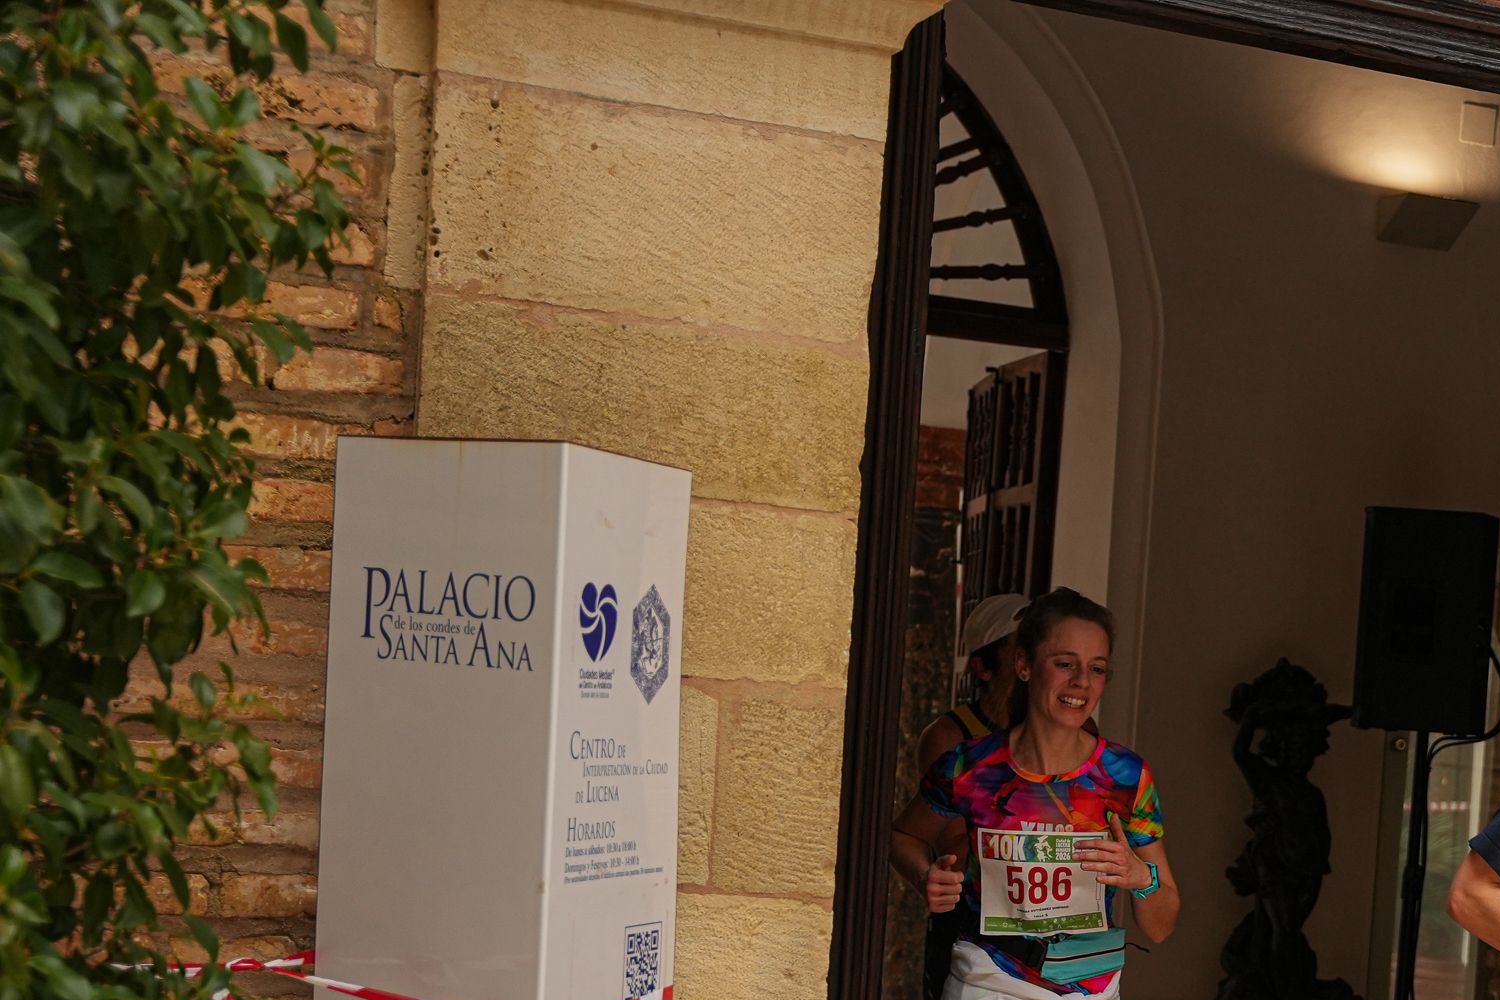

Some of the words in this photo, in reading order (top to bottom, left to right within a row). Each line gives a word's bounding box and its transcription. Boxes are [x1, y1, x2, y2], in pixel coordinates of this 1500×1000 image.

[360, 566, 536, 638] PALACIO
[393, 615, 406, 630] de
[409, 615, 424, 632] los
[426, 619, 461, 635] condes
[463, 619, 477, 636] de
[377, 613, 461, 667] SANTA
[466, 621, 534, 673] ANA
[570, 730, 616, 760] CENTRO
[617, 744, 626, 759] DE
[645, 759, 669, 776] CIUDAD
[575, 790, 584, 804] DE
[586, 780, 620, 803] LUCENA
[566, 817, 616, 843] HORARIOS
[988, 833, 1026, 861] 10K
[1055, 851, 1071, 861] 2026
[1006, 865, 1073, 905] 586
